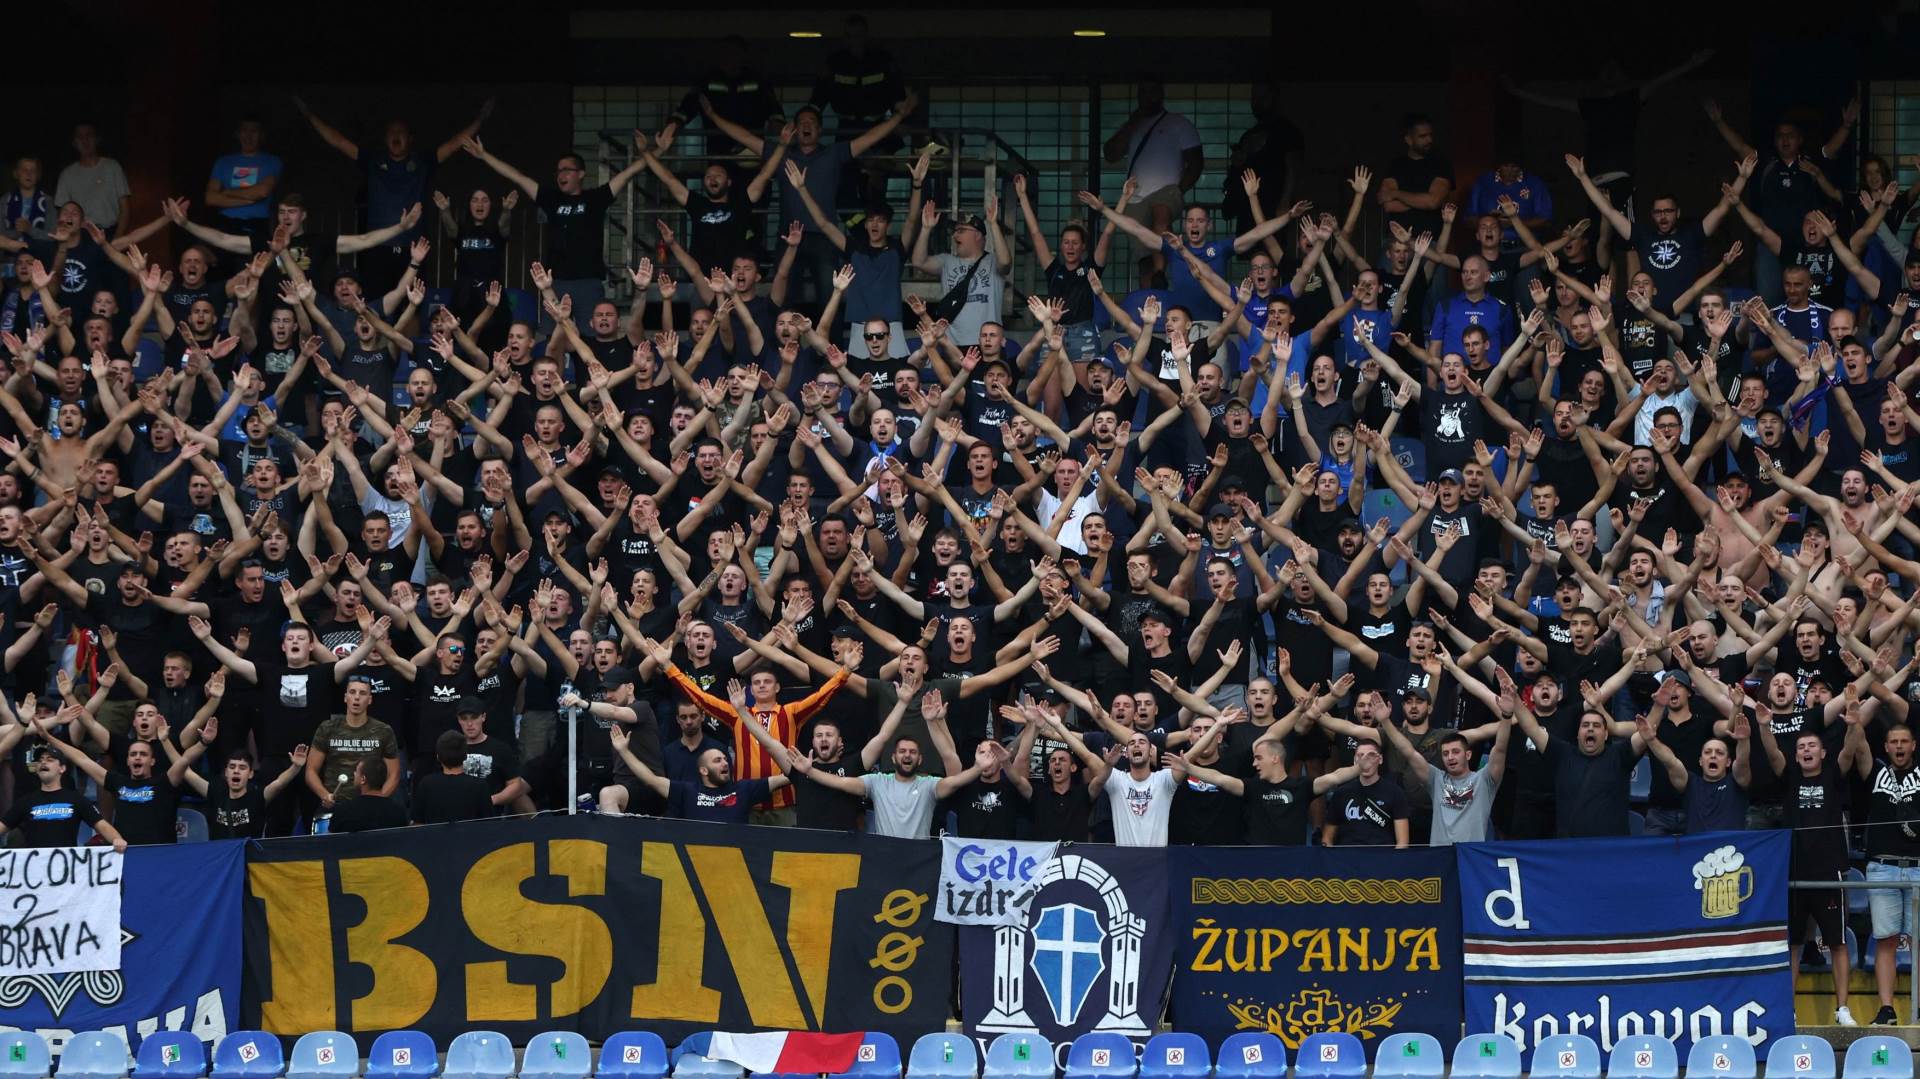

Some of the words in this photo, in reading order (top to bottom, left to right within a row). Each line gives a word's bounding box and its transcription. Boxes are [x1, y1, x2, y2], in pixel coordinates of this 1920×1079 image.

[330, 739, 343, 747] BAD
[343, 739, 361, 747] BLUE
[362, 739, 380, 748] BOYS
[955, 844, 1037, 884] Gele
[13, 893, 59, 931] 2
[946, 879, 1036, 917] izdr
[1484, 858, 1529, 930] d
[248, 838, 861, 1037] BSN
[1191, 918, 1441, 973] ŽUPANJA
[1302, 997, 1326, 1026] d
